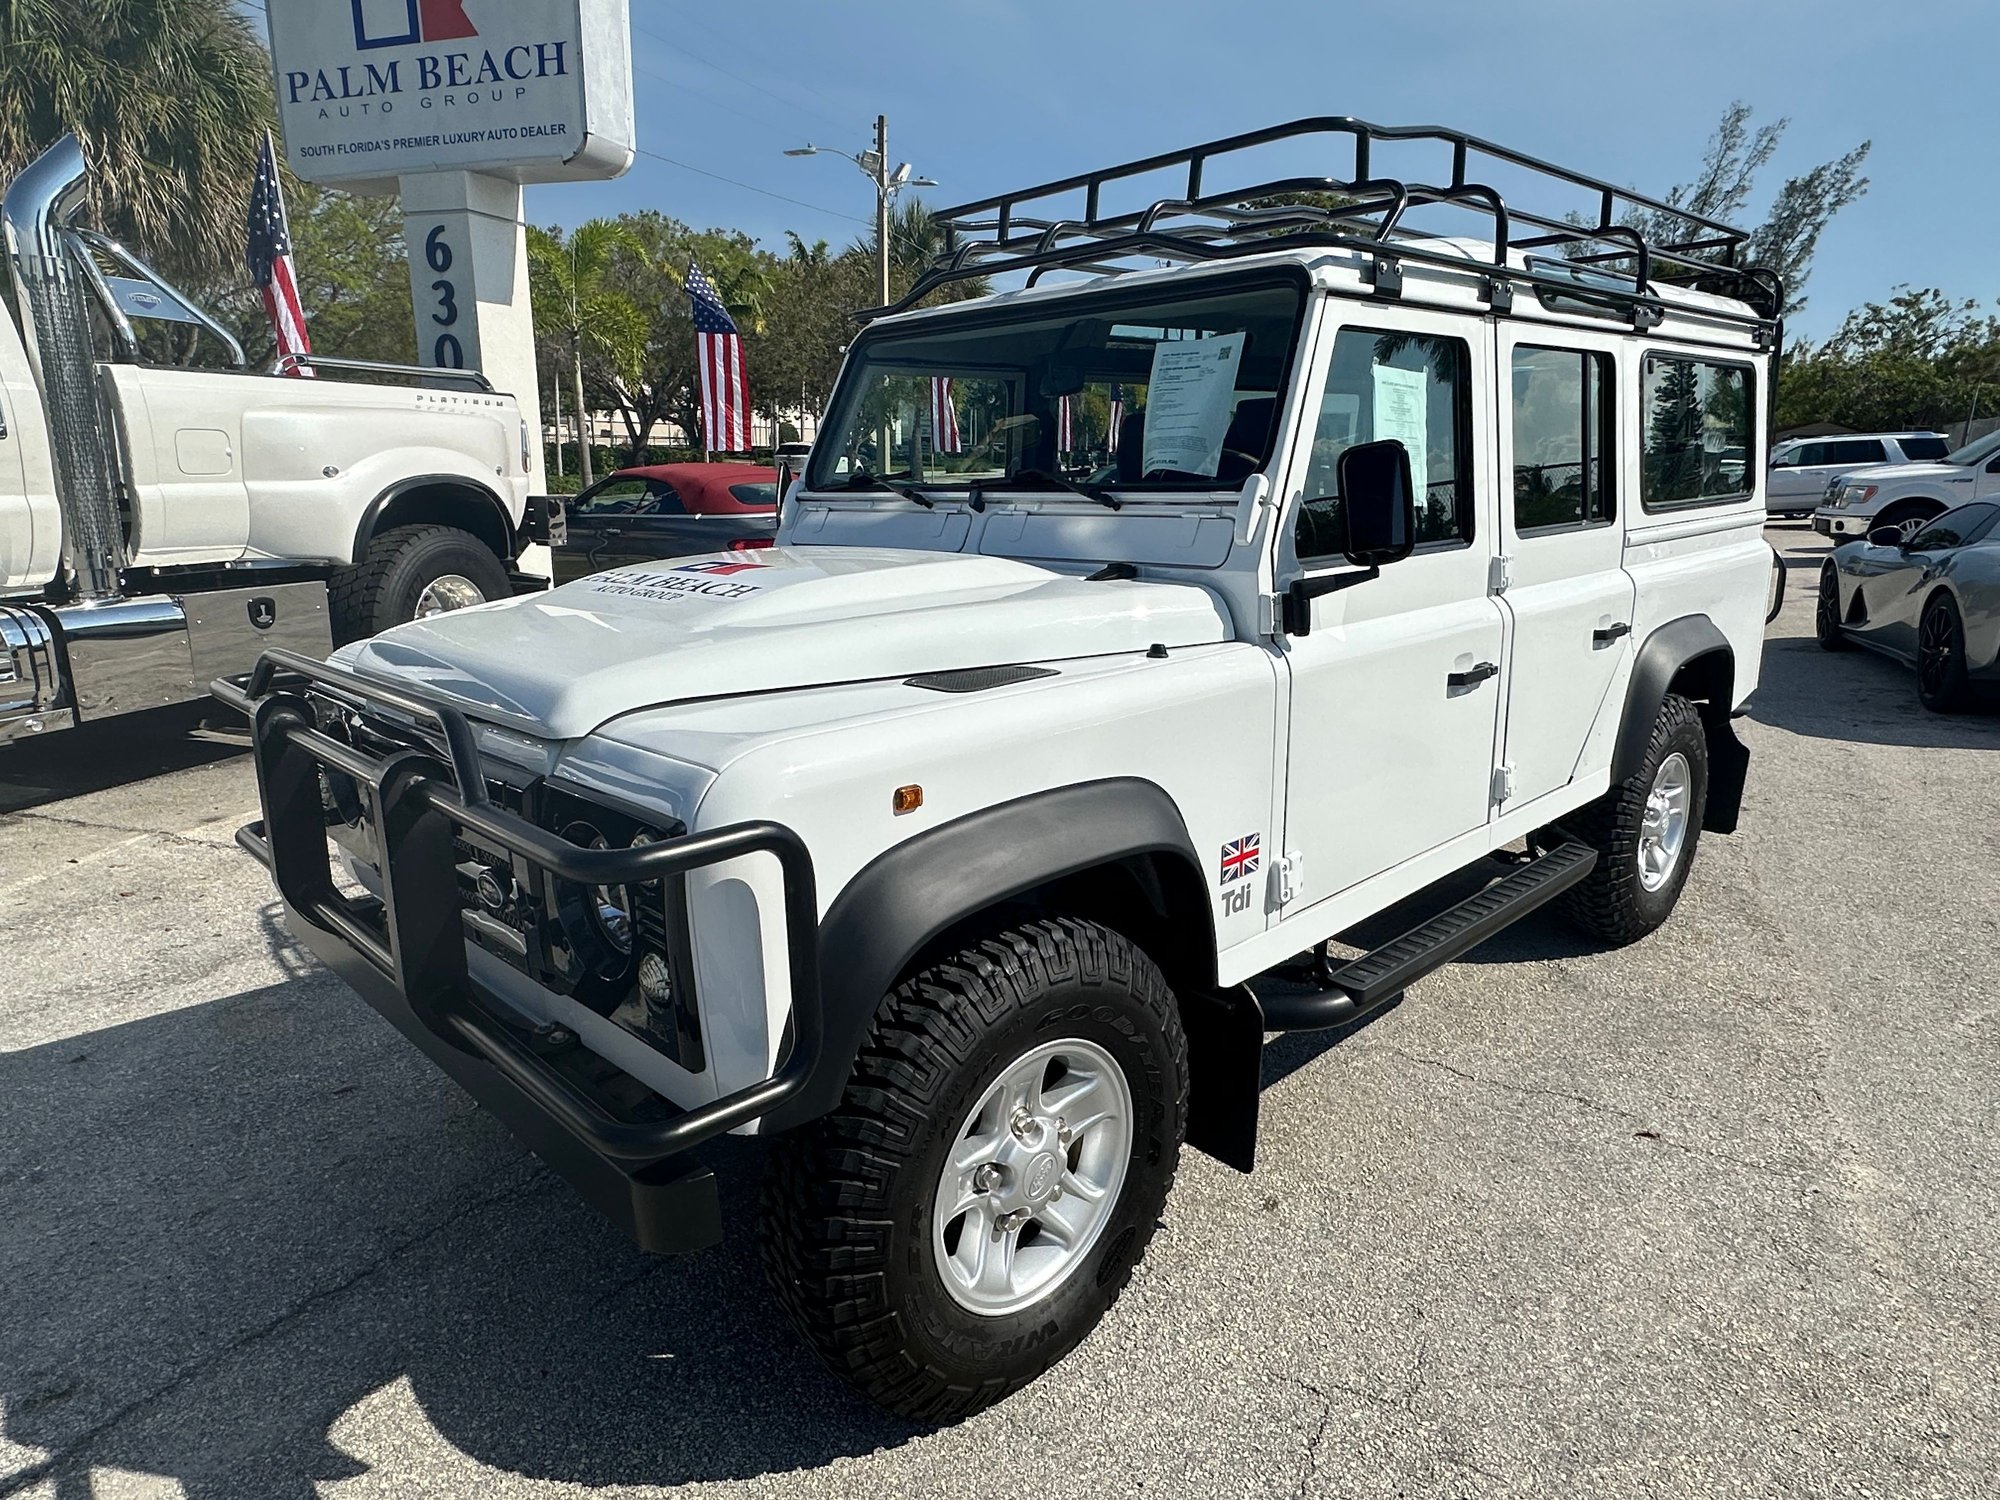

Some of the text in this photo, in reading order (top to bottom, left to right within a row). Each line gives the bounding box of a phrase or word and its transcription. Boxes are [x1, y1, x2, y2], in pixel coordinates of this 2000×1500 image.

[285, 40, 568, 104] PALM BEACH
[318, 87, 526, 119] AUTO GROUP
[300, 123, 567, 158] SOUTH FLORIDA'S PREMIER LUXURY AUTO DEALER
[416, 394, 504, 407] PLATINUM
[593, 585, 684, 600] AUTO GROUP
[660, 576, 763, 598] BEACH
[1221, 883, 1251, 917] Tdi
